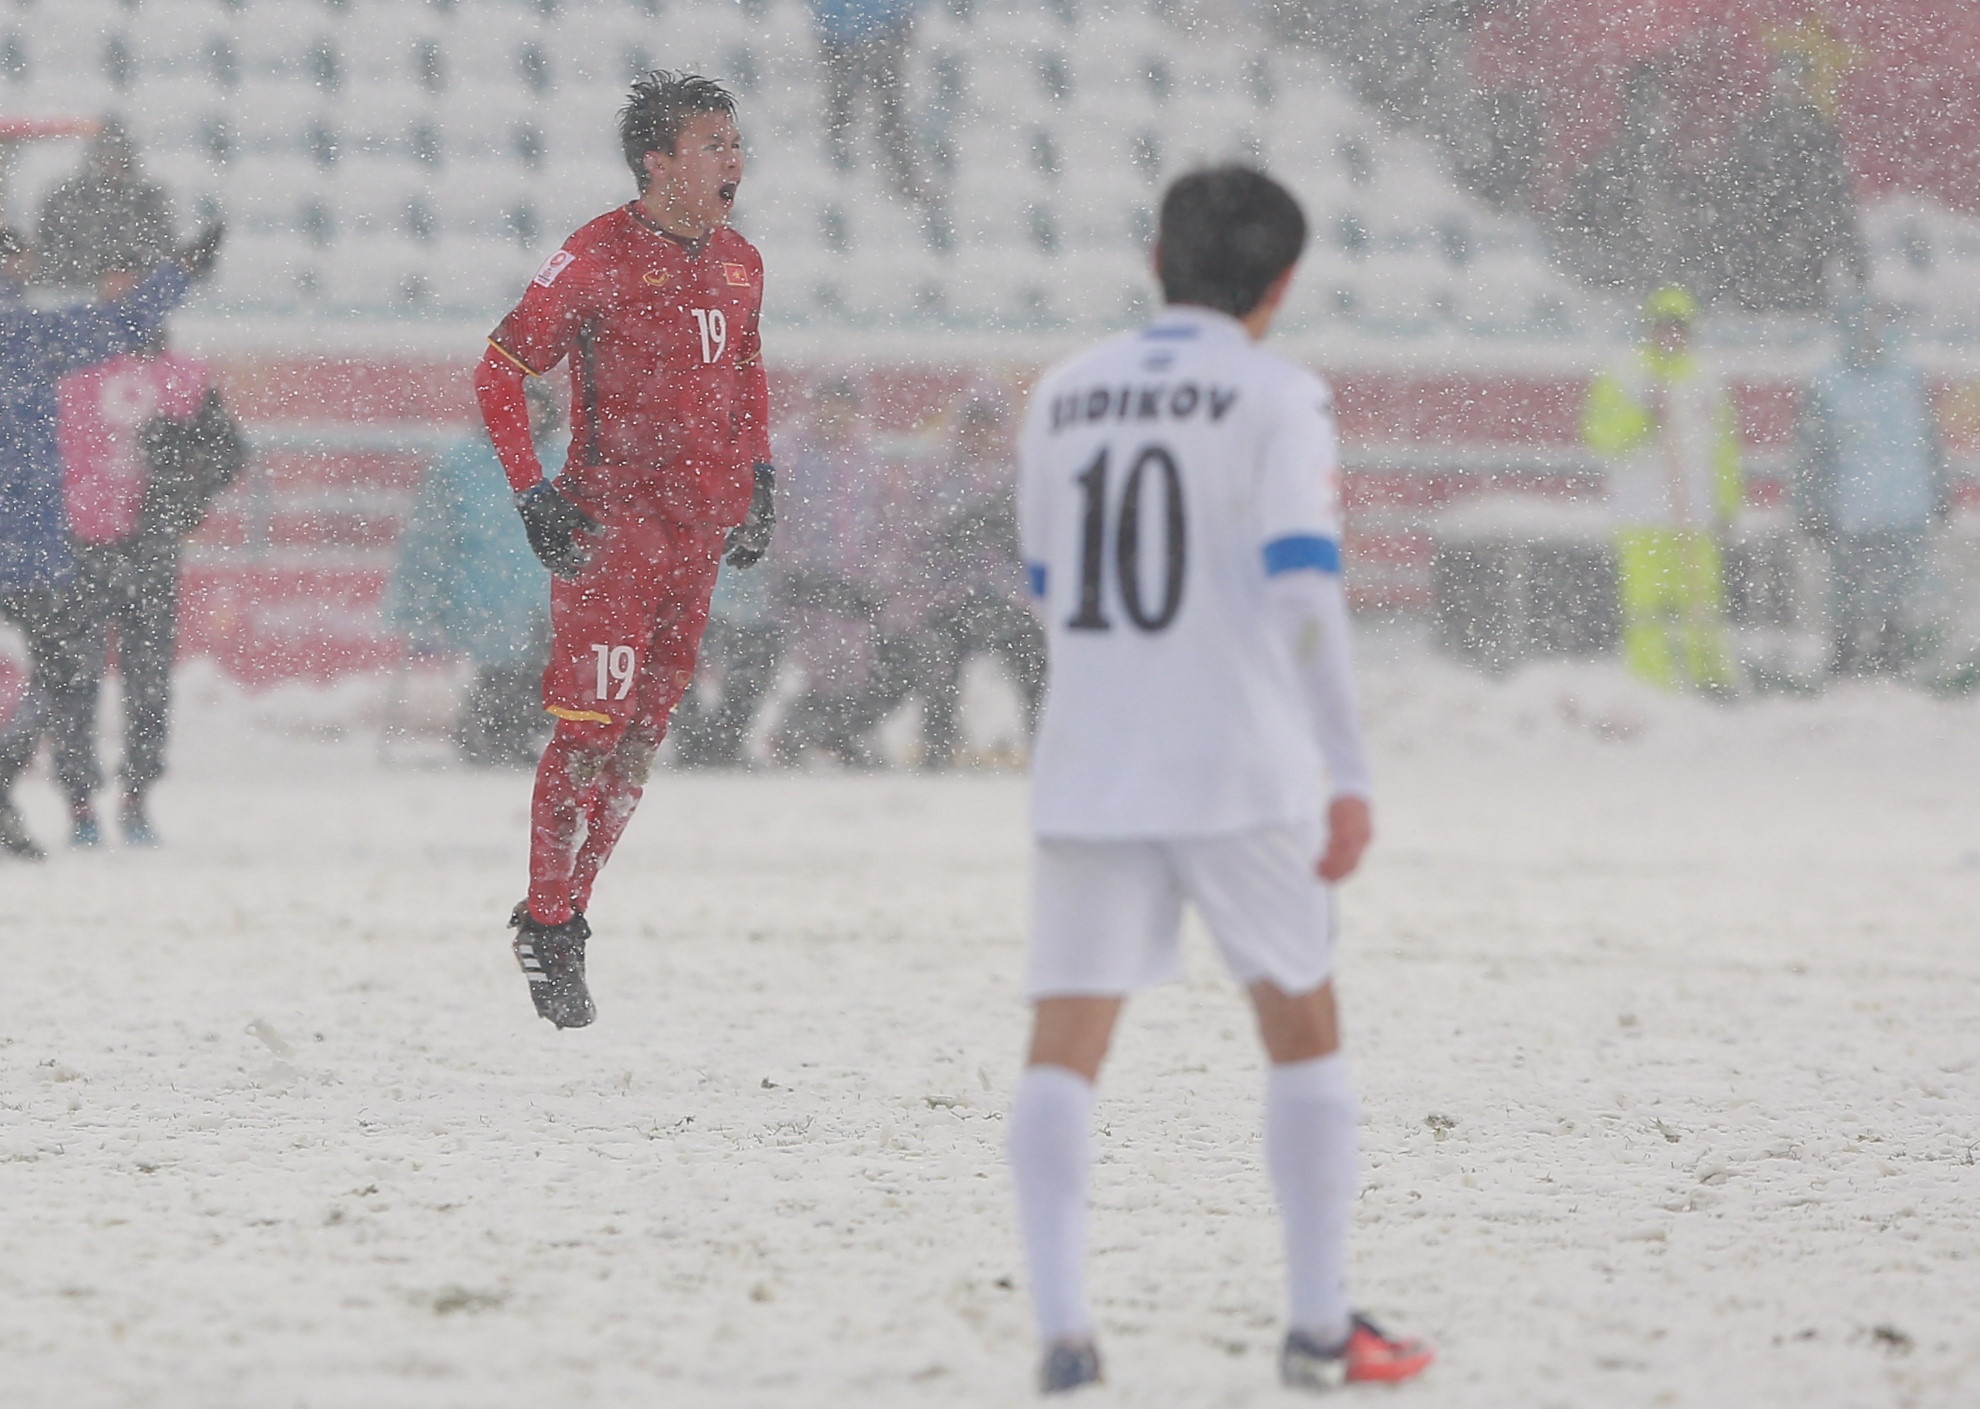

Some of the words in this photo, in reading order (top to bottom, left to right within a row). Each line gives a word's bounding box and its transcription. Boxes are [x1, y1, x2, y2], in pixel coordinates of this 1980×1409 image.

[691, 309, 727, 363] 19
[1066, 443, 1188, 633] 10
[592, 644, 635, 700] 19
